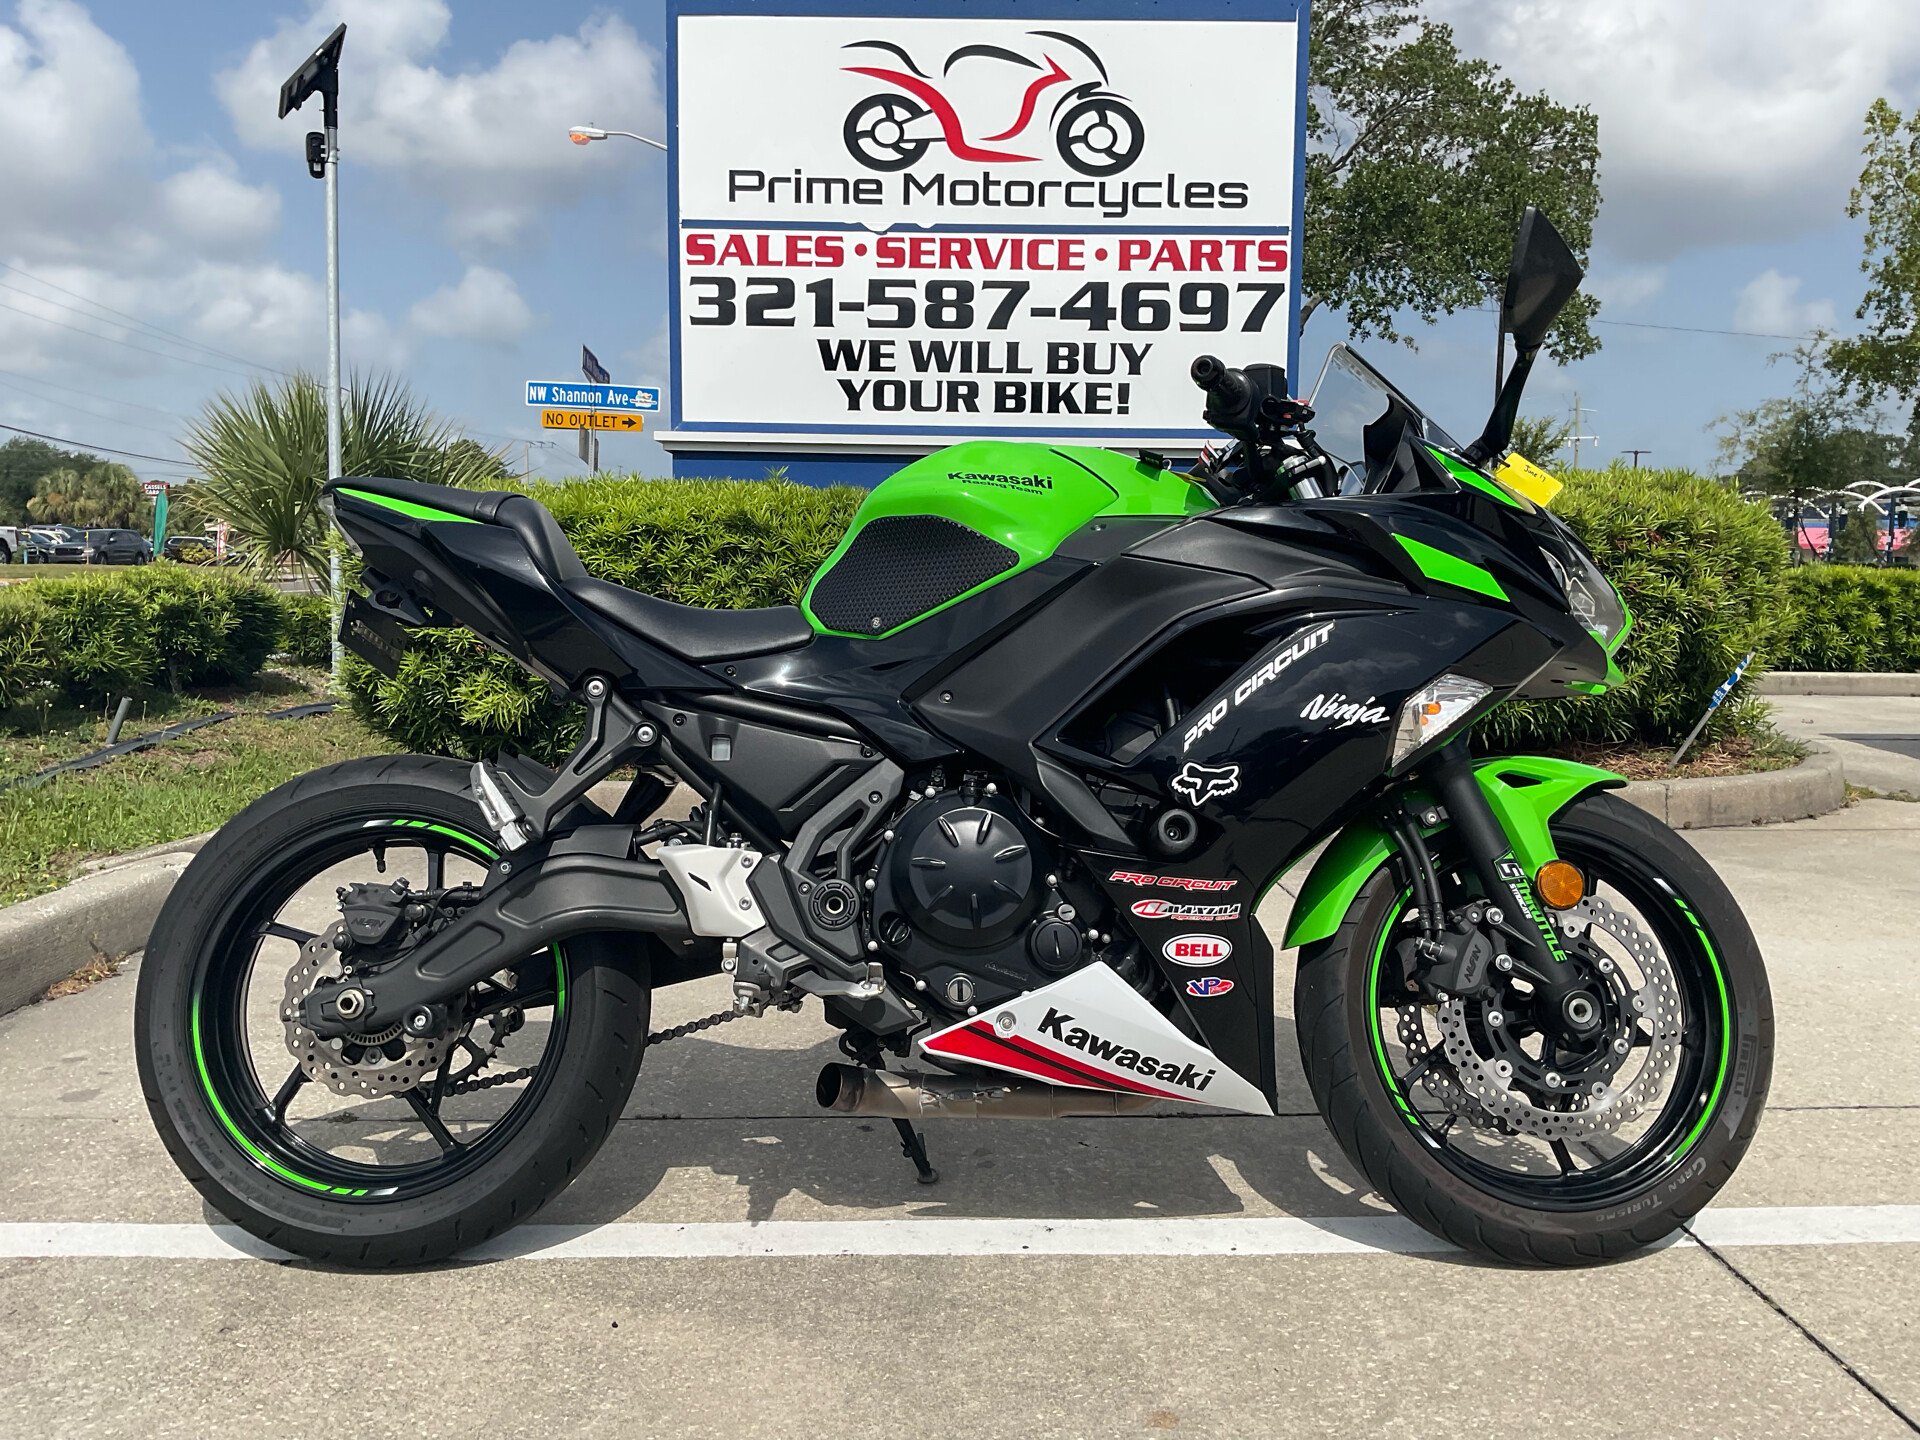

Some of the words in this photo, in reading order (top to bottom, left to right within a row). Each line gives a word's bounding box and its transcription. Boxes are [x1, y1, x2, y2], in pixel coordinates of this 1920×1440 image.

[729, 169, 884, 205] Prime
[903, 172, 1249, 218] Motorcycles
[686, 234, 844, 267] SALES
[876, 237, 1085, 271] SERVICE
[1118, 240, 1289, 273] PARTS
[689, 276, 1286, 332] 321-587-4697
[816, 339, 898, 373] WE
[908, 341, 1033, 375] WILL
[1046, 342, 1153, 376] BUY
[529, 386, 547, 401] NW
[552, 387, 602, 404] Shannon
[607, 389, 628, 405] Ave
[836, 379, 981, 414] YOUR
[993, 381, 1131, 415] BIKE!
[546, 413, 564, 425] NO
[569, 414, 618, 428] OUTLET
[947, 472, 1053, 489] Kawasaki
[962, 479, 1007, 489] Racing
[1008, 484, 1043, 495] Team
[1183, 698, 1228, 753] PRO
[1233, 620, 1336, 706] CIRCUIT
[1300, 692, 1391, 730] Ninja
[1109, 870, 1158, 887] PRO
[1157, 876, 1238, 892] CIRCUIT
[1174, 943, 1223, 957] BELL
[1187, 977, 1220, 995] VP
[1037, 1006, 1217, 1092] Kawasaki
